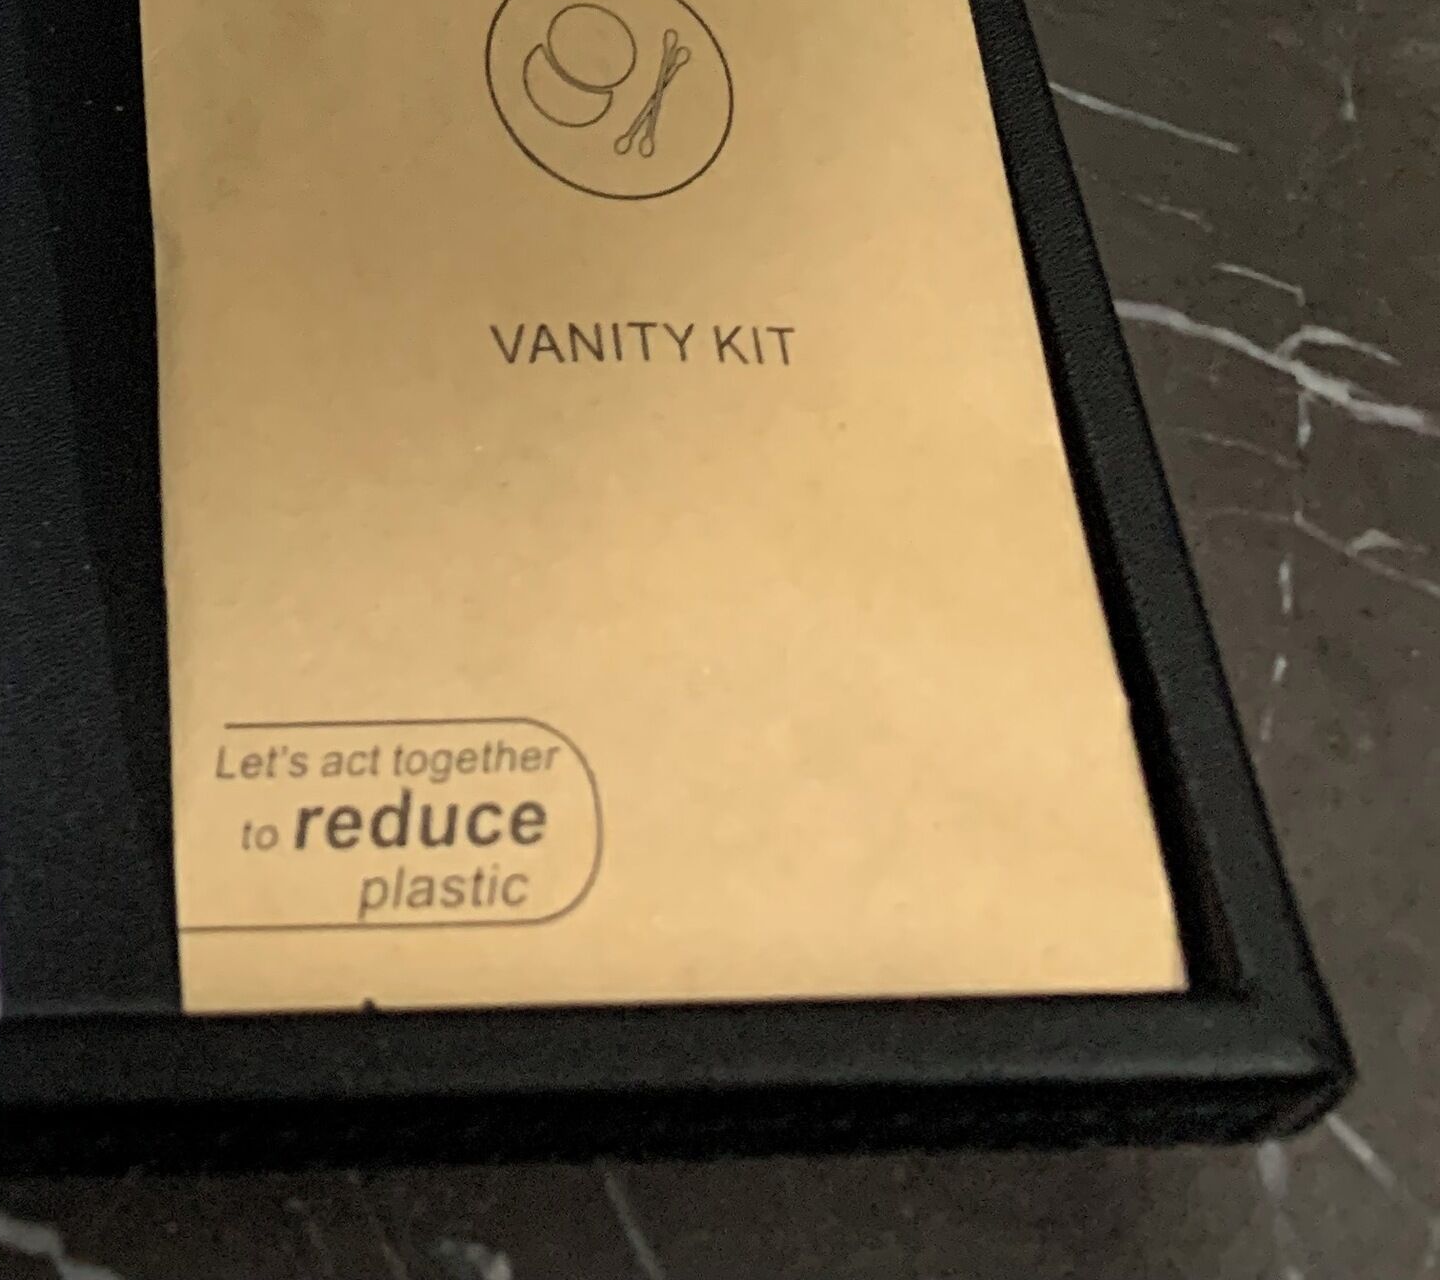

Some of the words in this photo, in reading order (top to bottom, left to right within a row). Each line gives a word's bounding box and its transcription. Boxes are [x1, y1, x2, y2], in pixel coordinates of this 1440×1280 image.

[490, 322, 695, 364] VANITY
[713, 325, 795, 366] KIT
[215, 745, 309, 780] Let's
[320, 745, 381, 778] act
[392, 739, 561, 785] together
[240, 820, 279, 851] to
[294, 786, 548, 850] reduce
[358, 862, 530, 922] plastic
